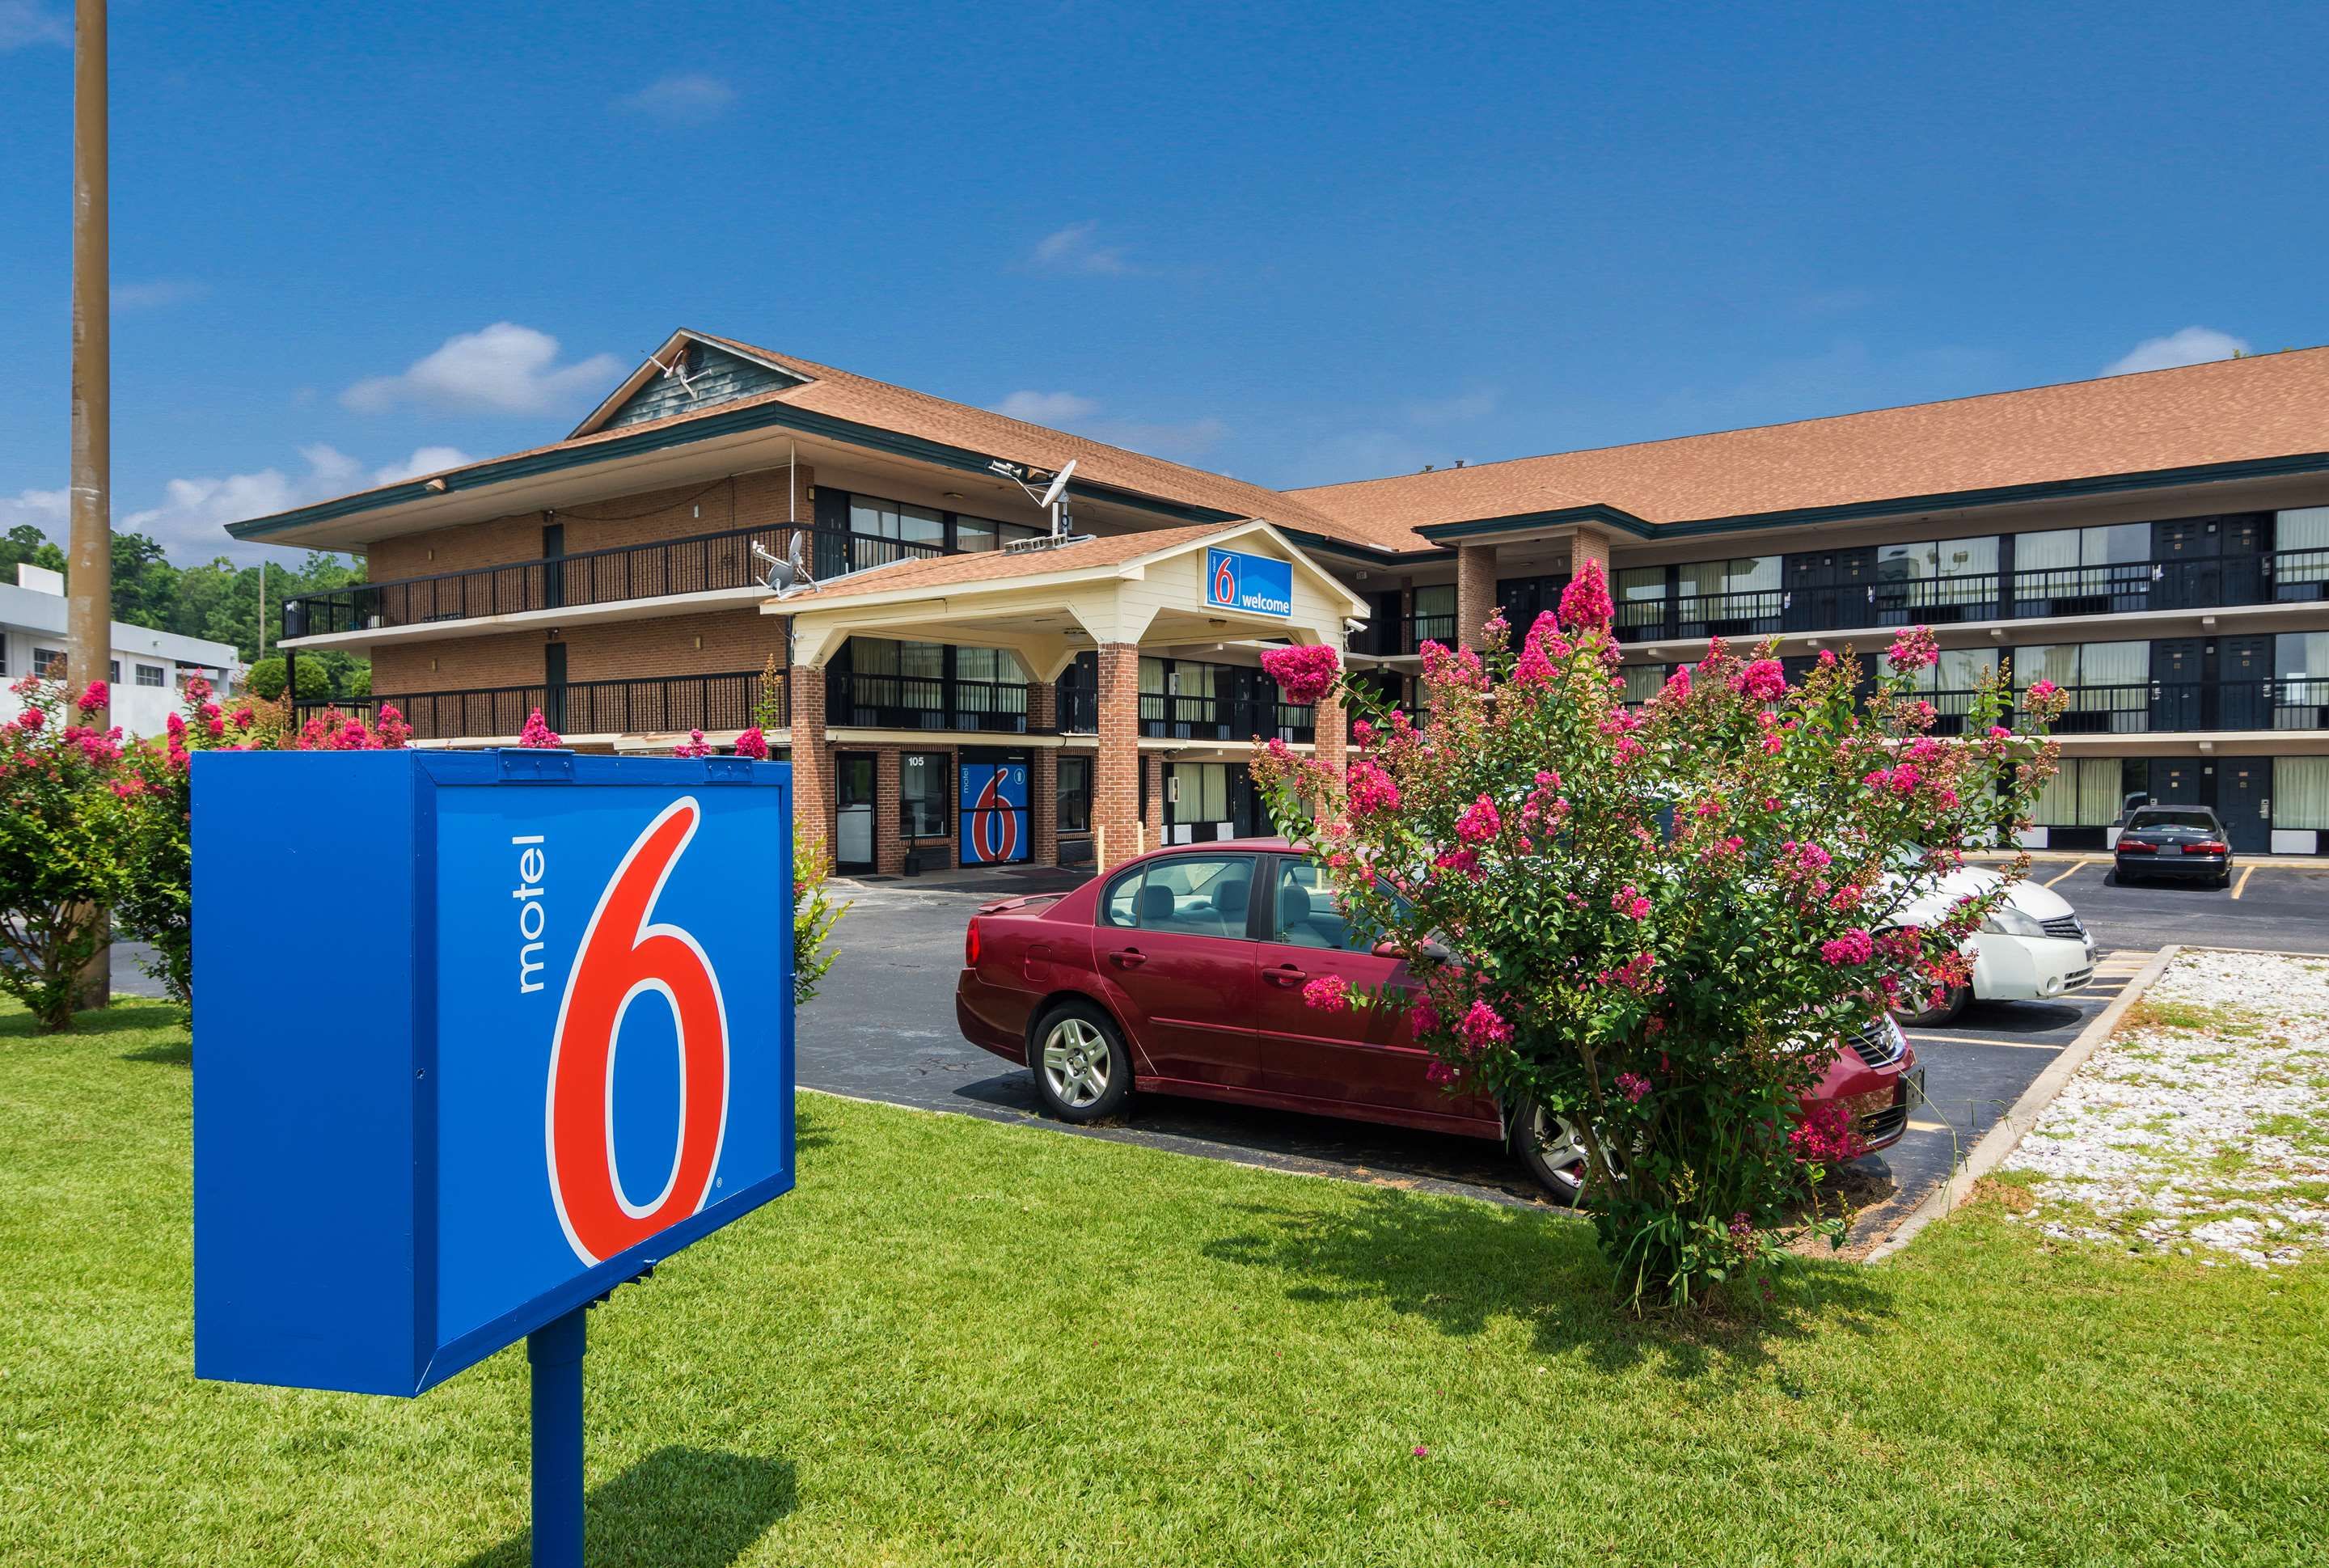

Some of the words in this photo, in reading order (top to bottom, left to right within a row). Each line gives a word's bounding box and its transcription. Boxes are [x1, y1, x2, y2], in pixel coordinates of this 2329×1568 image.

[1215, 556, 1235, 604] 6
[1242, 593, 1289, 613] welcome
[908, 756, 924, 767] 105
[972, 768, 1017, 861] 6
[513, 835, 545, 994] motel
[546, 795, 730, 1268] 6
